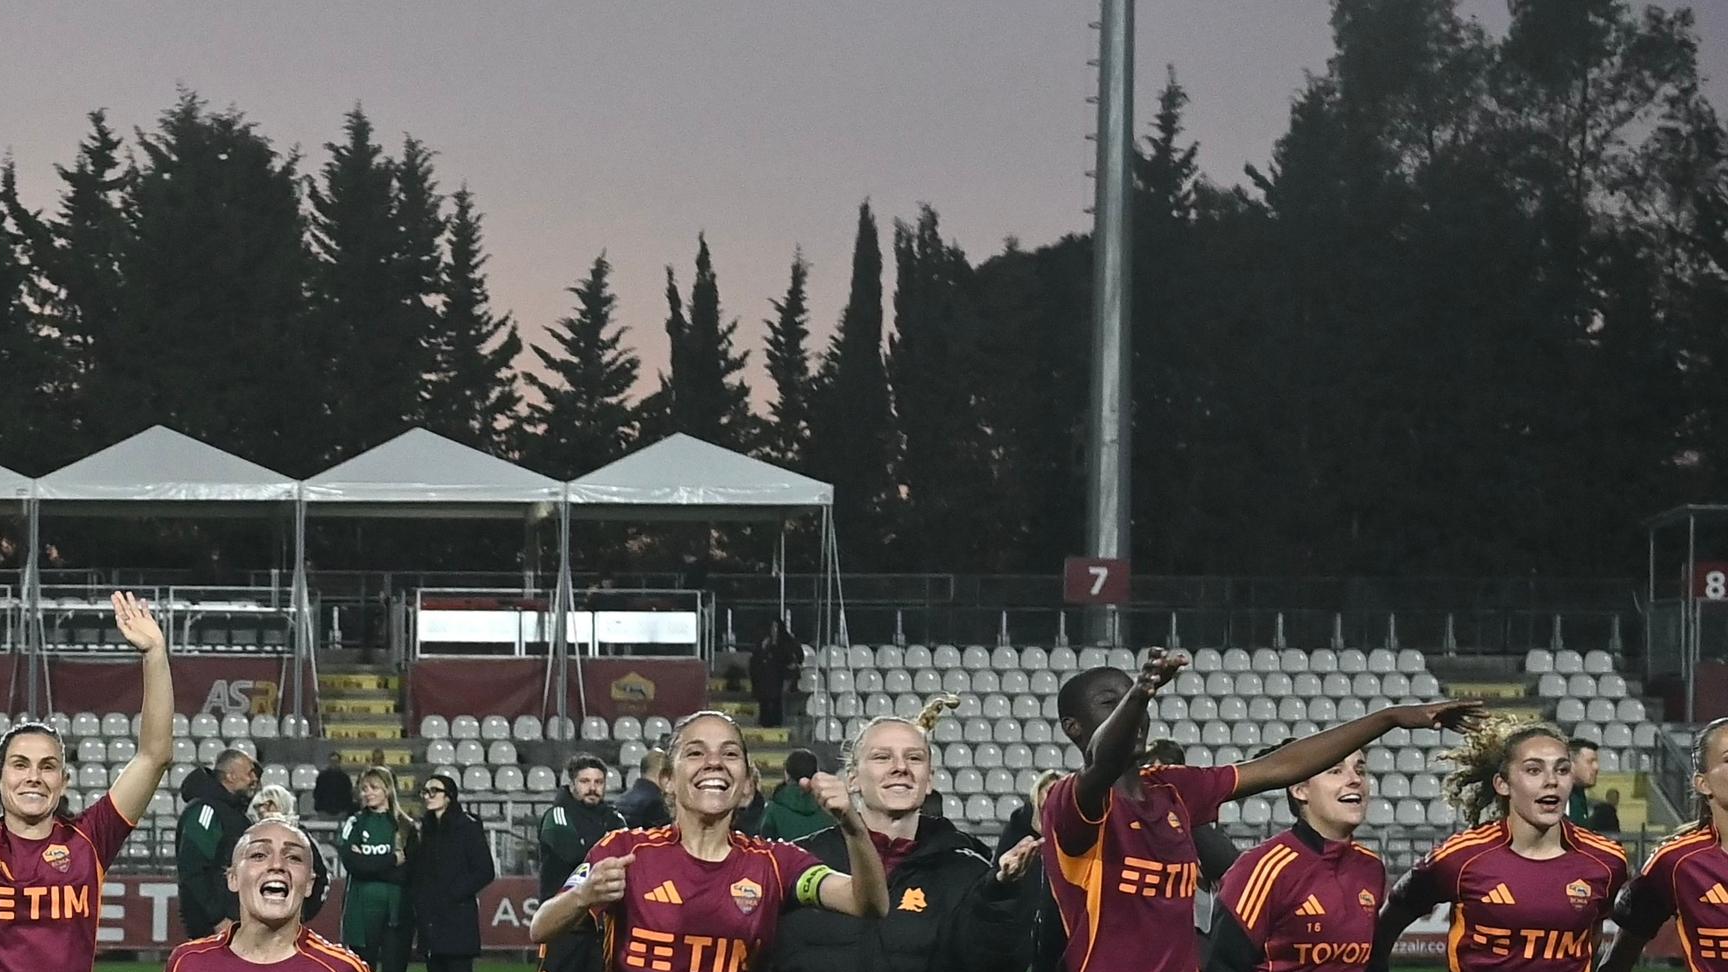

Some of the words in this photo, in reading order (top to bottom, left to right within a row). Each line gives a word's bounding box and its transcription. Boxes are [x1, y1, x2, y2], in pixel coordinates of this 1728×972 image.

[1089, 567, 1108, 595] 7
[1706, 571, 1725, 600] 8
[202, 679, 278, 717] ASR
[23, 885, 90, 920] TIM
[1306, 922, 1321, 933] 16
[1392, 939, 1446, 954] zzair.co
[1520, 928, 1589, 960] TIM
